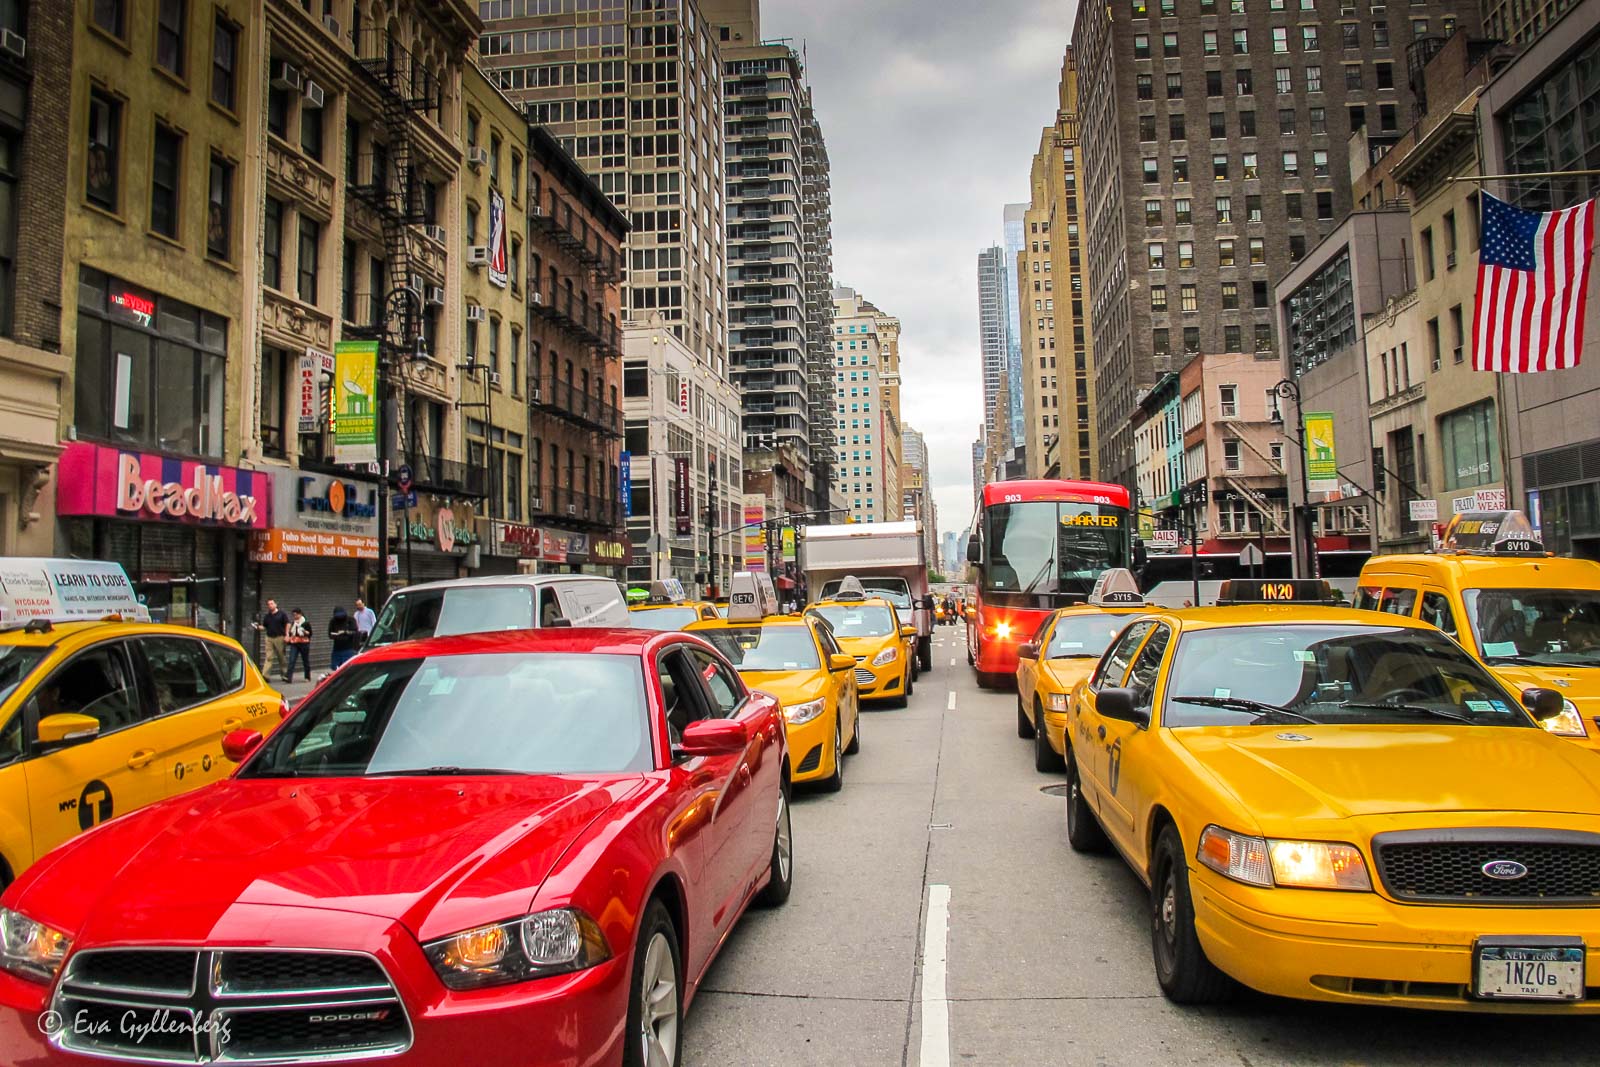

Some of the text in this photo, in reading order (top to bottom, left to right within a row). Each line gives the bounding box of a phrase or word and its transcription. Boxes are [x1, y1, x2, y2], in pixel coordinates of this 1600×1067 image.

[123, 292, 154, 315] EVENT
[302, 370, 313, 416] BARBER
[680, 383, 688, 407] PARK
[117, 453, 257, 523] BeadMax
[297, 476, 330, 512] Fun
[1004, 494, 1022, 503] 903
[1093, 495, 1111, 504] 903
[1476, 491, 1505, 501] MEN'S
[1455, 496, 1474, 512] PRATO
[1477, 501, 1505, 511] WEAR
[1060, 514, 1119, 528] CHARTER
[1152, 530, 1177, 541] NAILS!
[281, 543, 317, 555] Swarovski
[1507, 541, 1530, 551] 8V10
[54, 573, 128, 587] LEARN TO CODE
[1113, 593, 1132, 601] 3Y15
[1260, 583, 1293, 600] 1N20
[733, 594, 753, 604] 8E76
[59, 798, 77, 813] NYC
[1493, 863, 1517, 875] Ford
[1505, 951, 1557, 961] NEW YORK
[309, 1012, 380, 1022] DODGE
